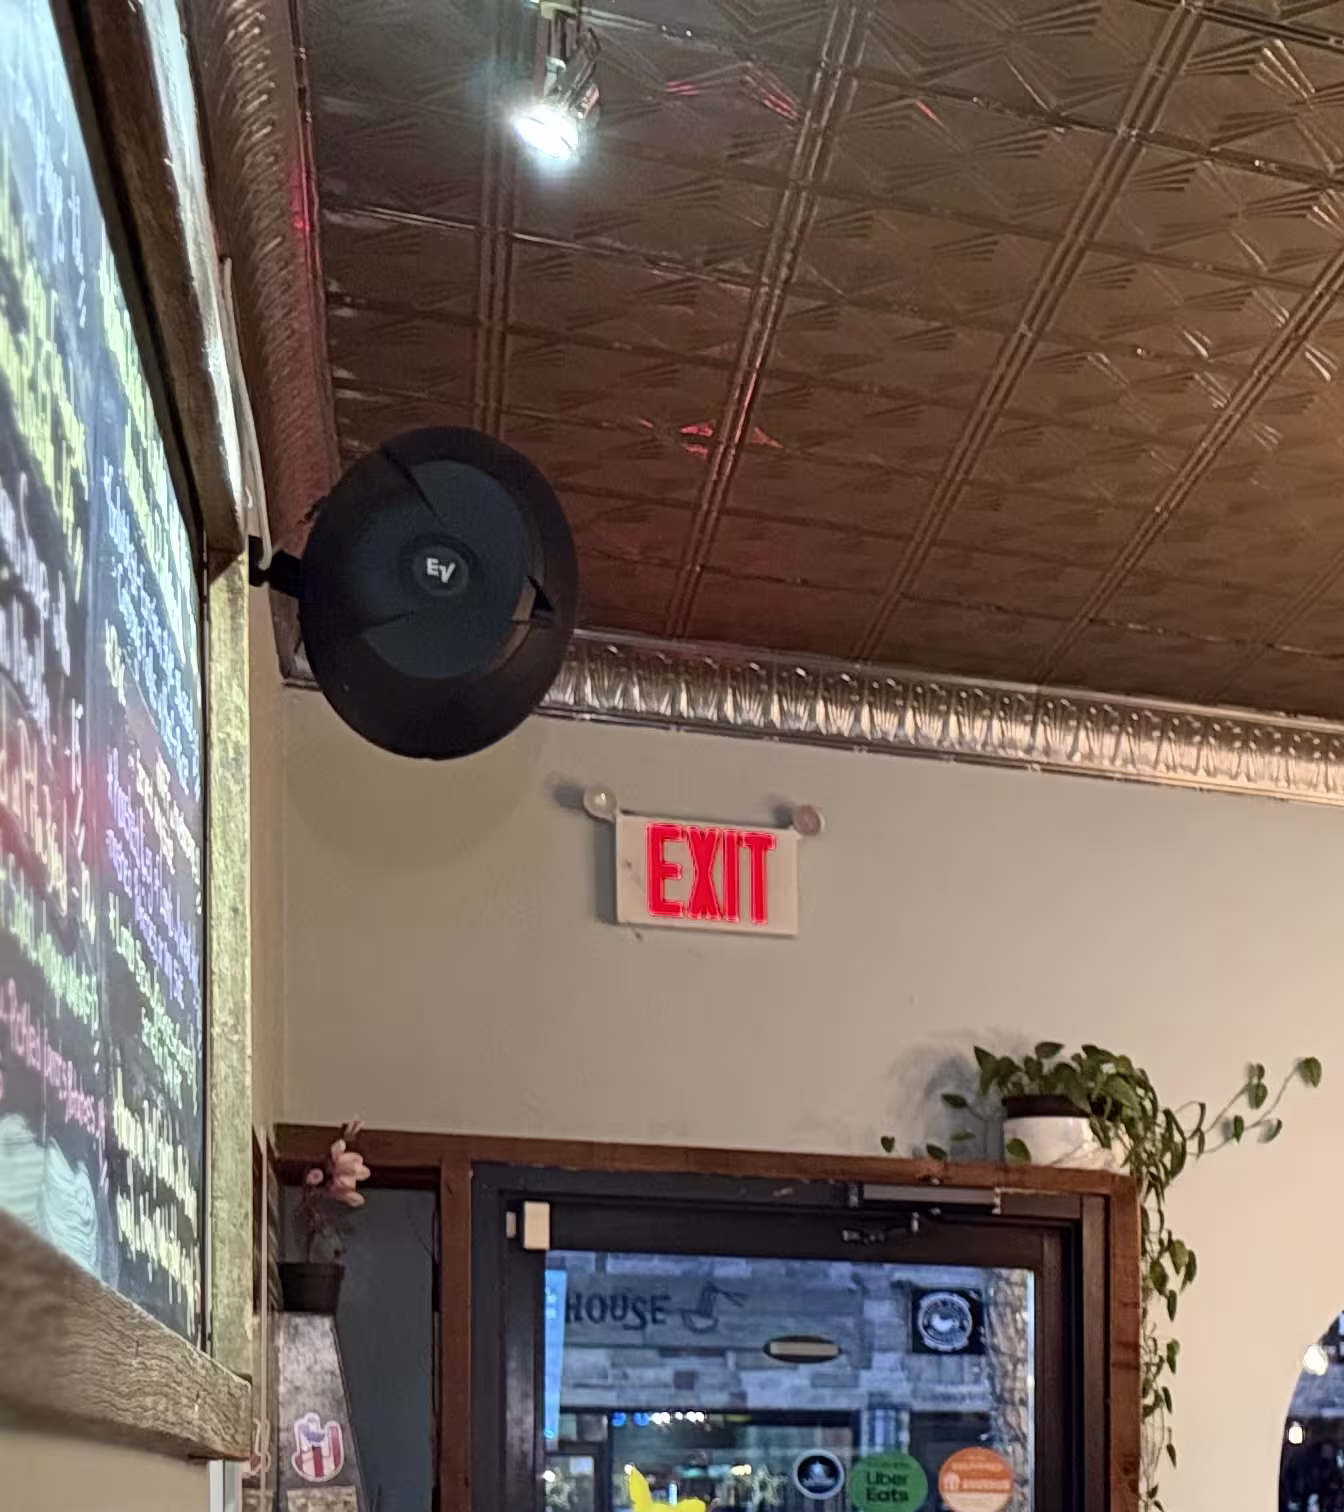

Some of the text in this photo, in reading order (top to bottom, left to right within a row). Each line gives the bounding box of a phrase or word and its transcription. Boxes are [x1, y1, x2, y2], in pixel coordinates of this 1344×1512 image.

[646, 822, 776, 925] EXIT
[566, 1290, 672, 1331] HOUSE
[866, 1471, 908, 1486] Uber
[866, 1487, 910, 1502] Eats
